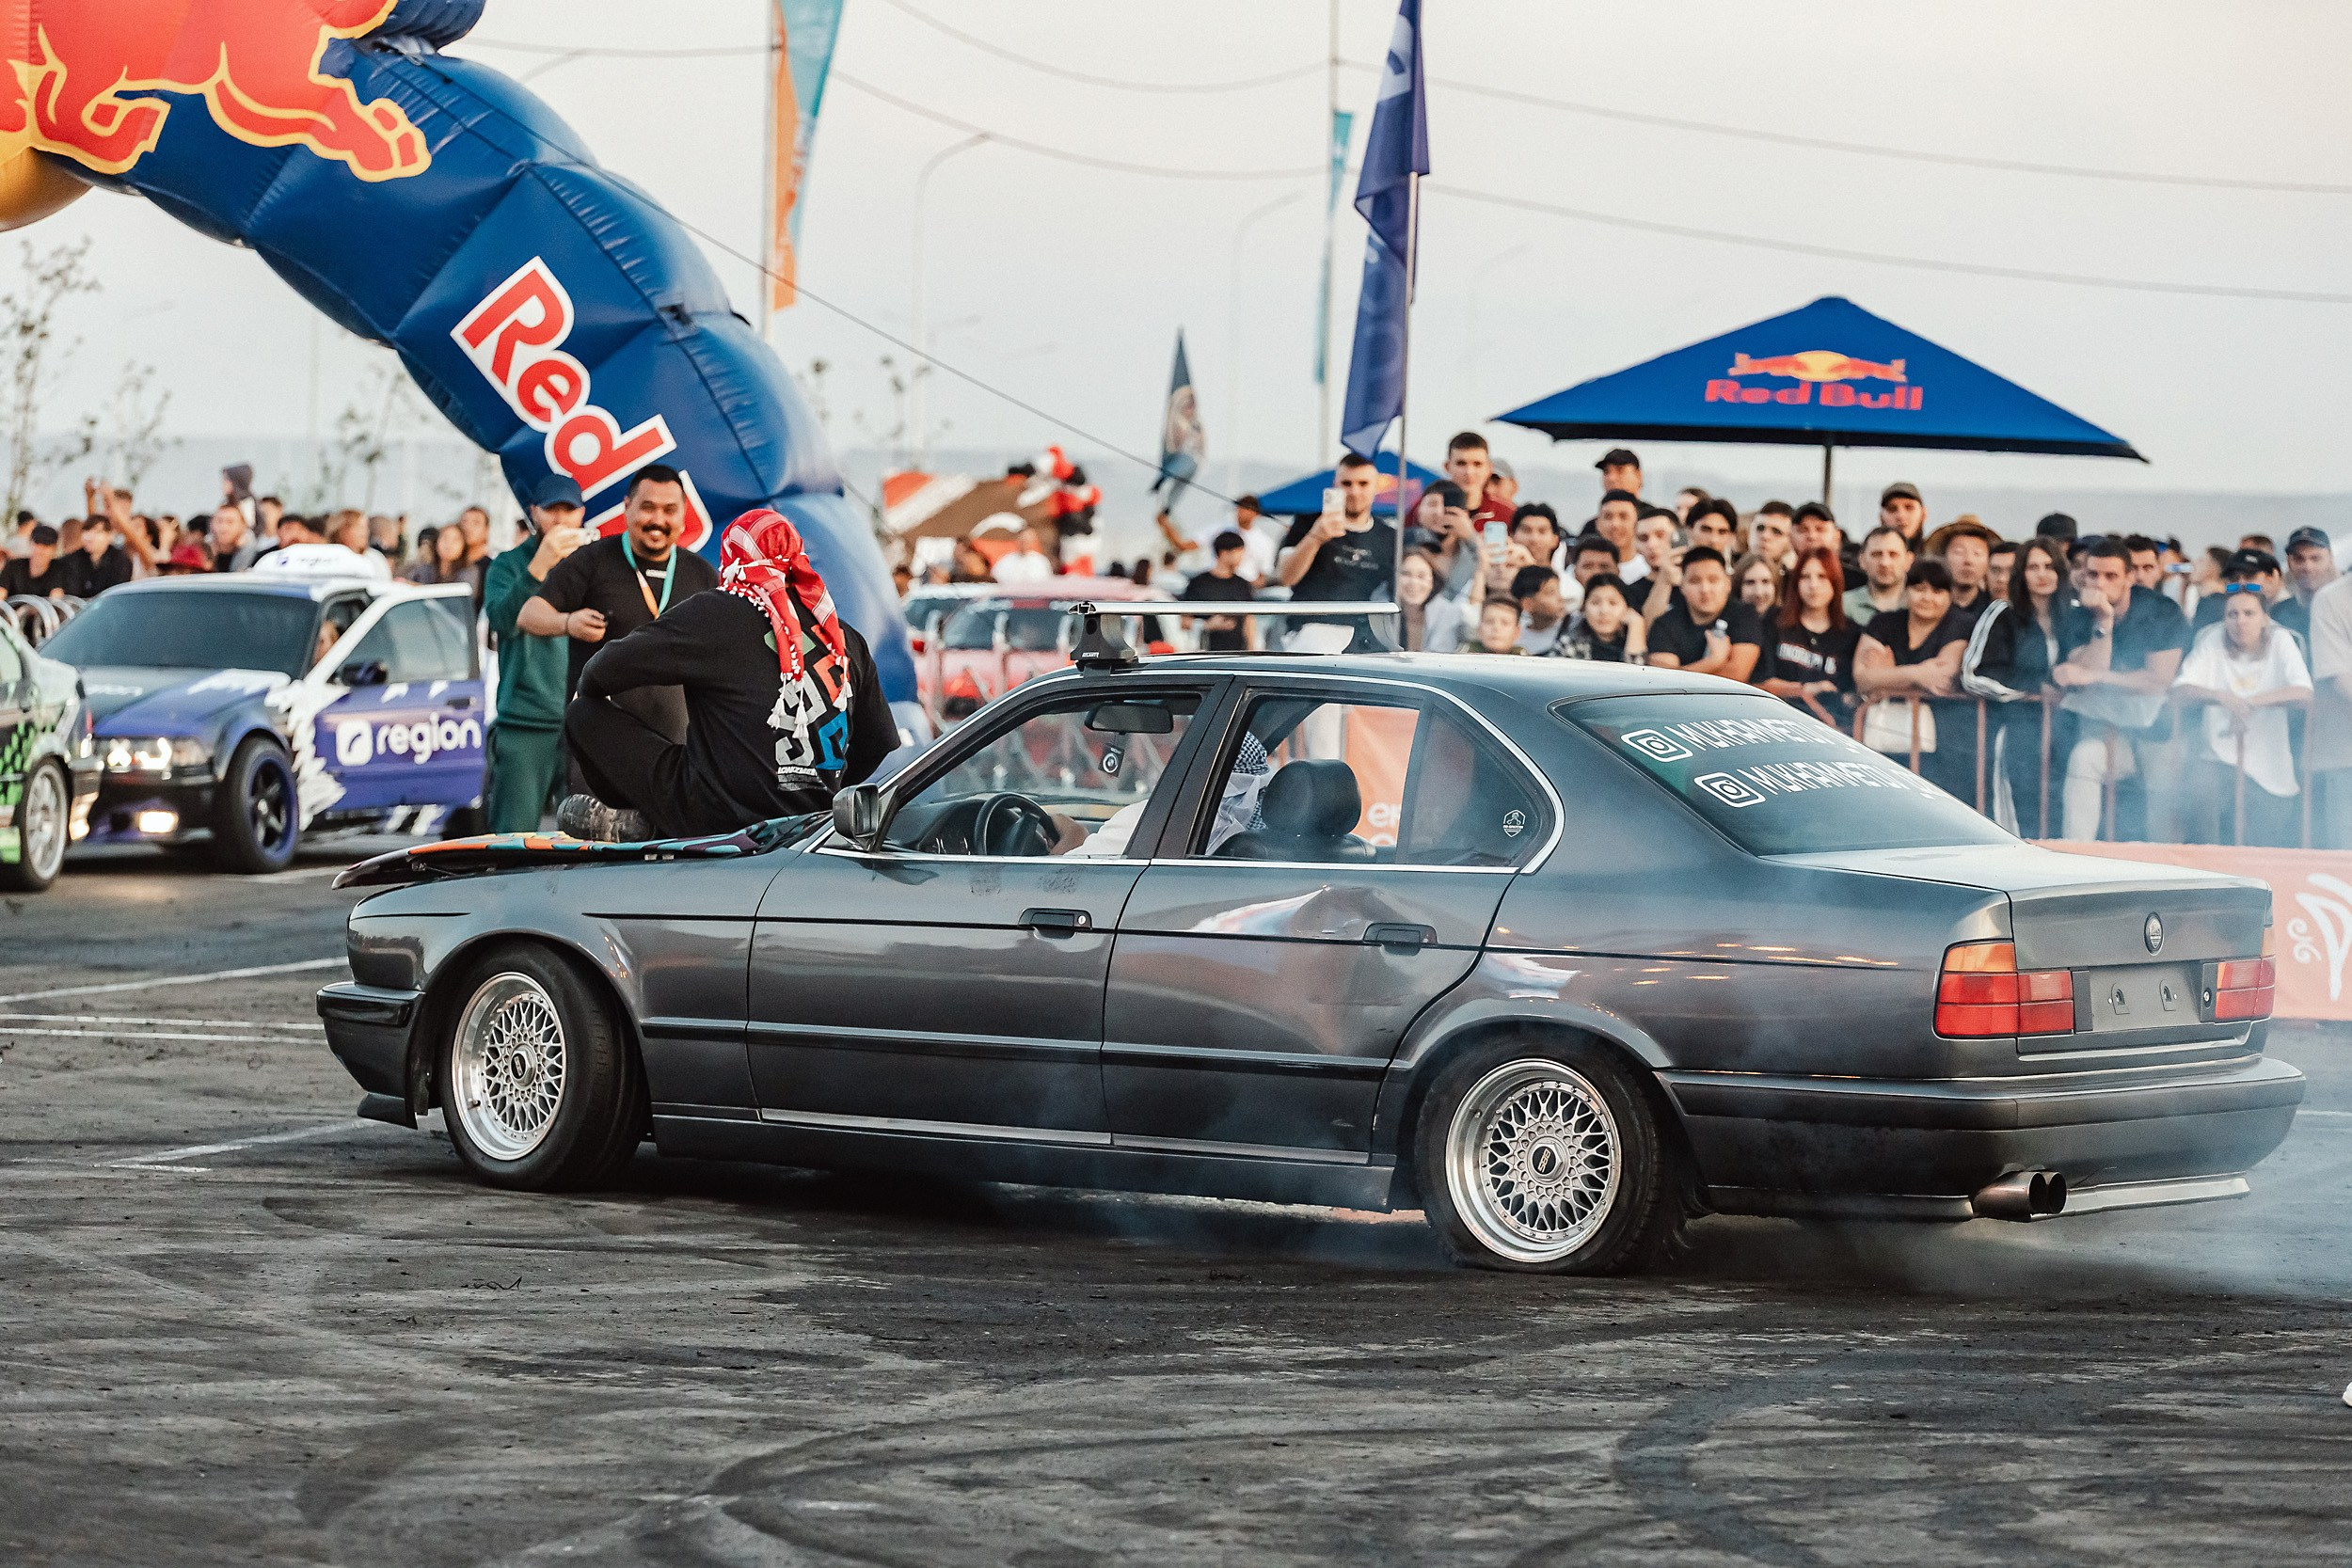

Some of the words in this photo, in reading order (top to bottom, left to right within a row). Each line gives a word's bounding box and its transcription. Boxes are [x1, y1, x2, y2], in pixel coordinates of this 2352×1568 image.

[452, 257, 675, 499] Red
[1705, 379, 1811, 404] Red
[1820, 382, 1923, 410] Bull
[377, 712, 482, 765] region
